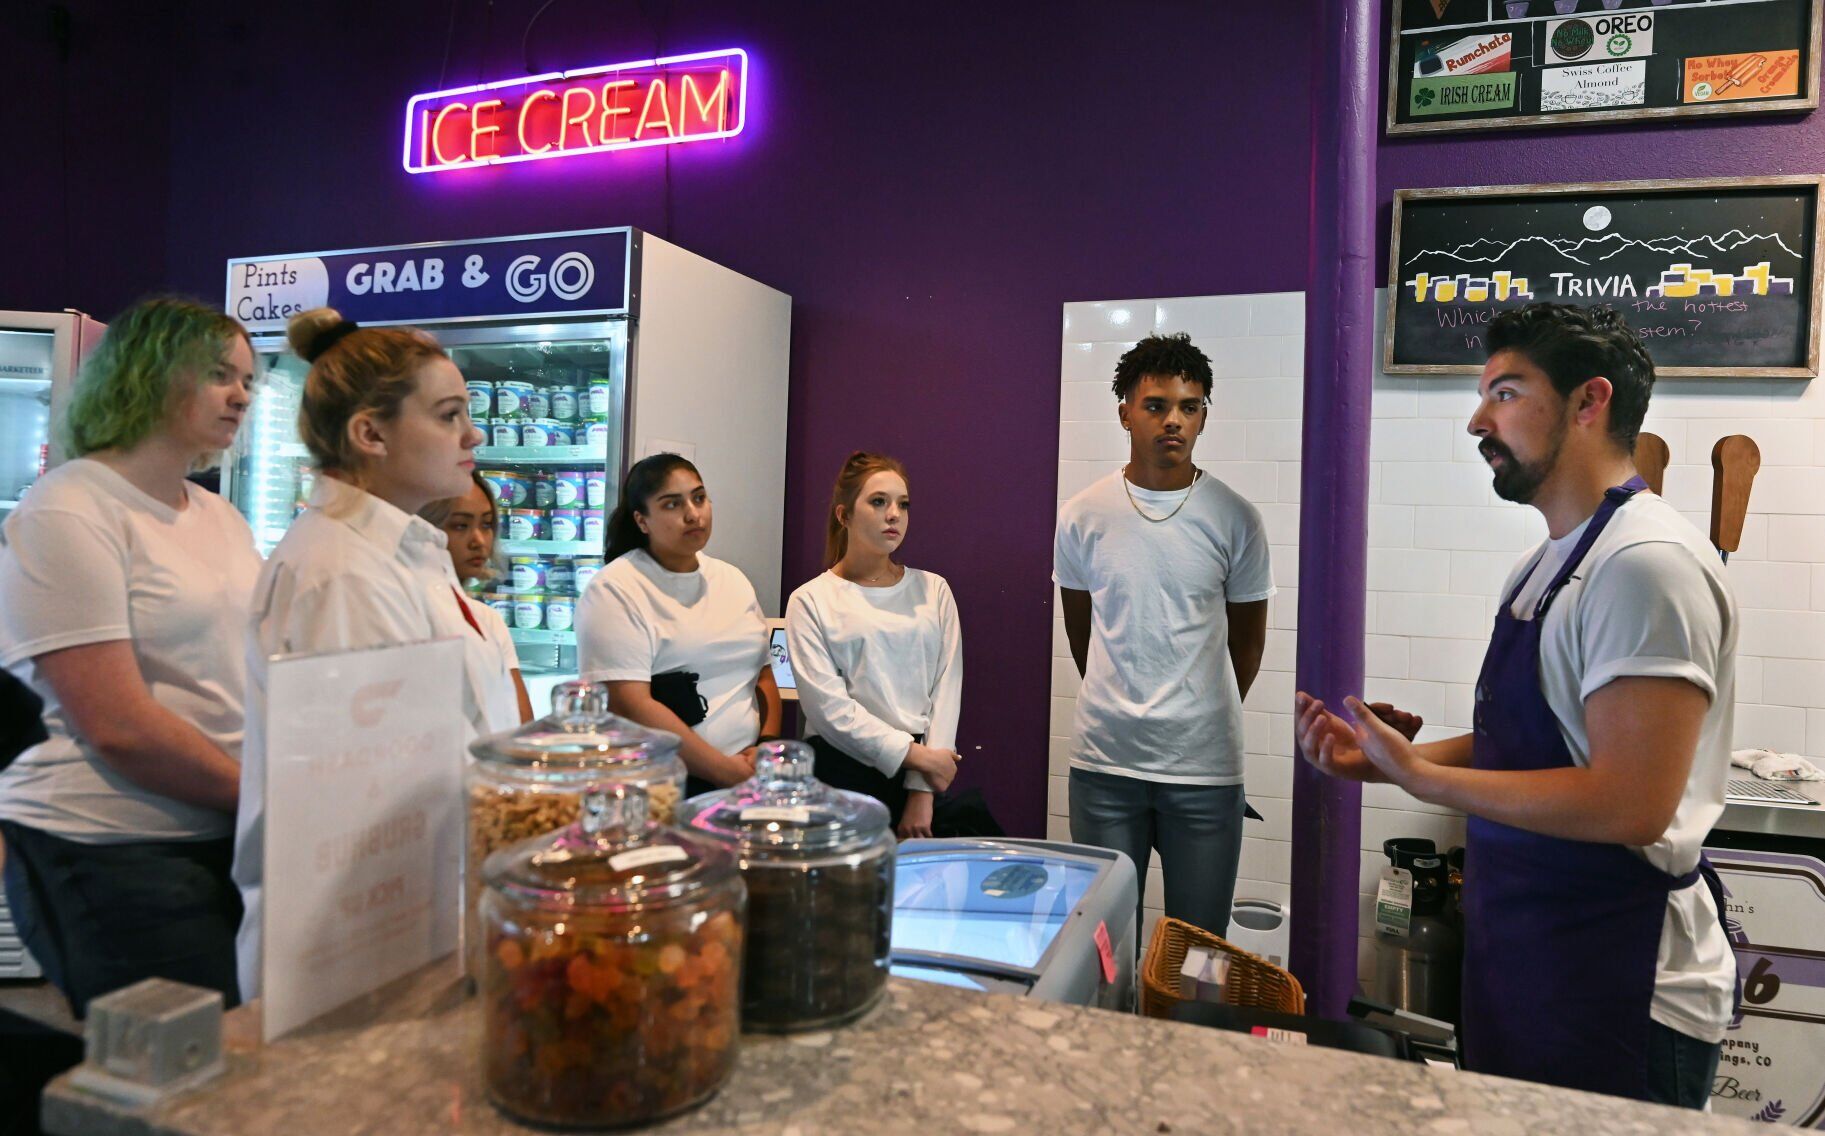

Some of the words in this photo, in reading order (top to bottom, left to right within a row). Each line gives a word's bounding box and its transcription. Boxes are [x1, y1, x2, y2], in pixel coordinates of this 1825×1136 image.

[1595, 15, 1653, 35] OREO
[1445, 33, 1512, 72] Rumchata
[1562, 67, 1593, 78] Swiss
[1596, 63, 1633, 75] Coffee
[1687, 60, 1703, 69] No
[1575, 76, 1619, 89] Almond
[1440, 86, 1469, 105] IRISH
[1471, 83, 1511, 103] CREAM
[421, 99, 503, 168] ICE
[518, 70, 728, 155] CREAM
[244, 263, 297, 288] Pints
[345, 258, 445, 296] GRAB
[461, 254, 490, 289] &
[505, 251, 595, 303] GO
[1550, 272, 1637, 298] TRIVIA
[1632, 299, 1667, 313] the
[1684, 299, 1749, 314] hottest
[1464, 334, 1483, 349] in
[1639, 319, 1702, 339] stem?
[1723, 898, 1754, 914] hn's
[1756, 1056, 1772, 1067] CO
[1710, 1075, 1762, 1102] Beer
